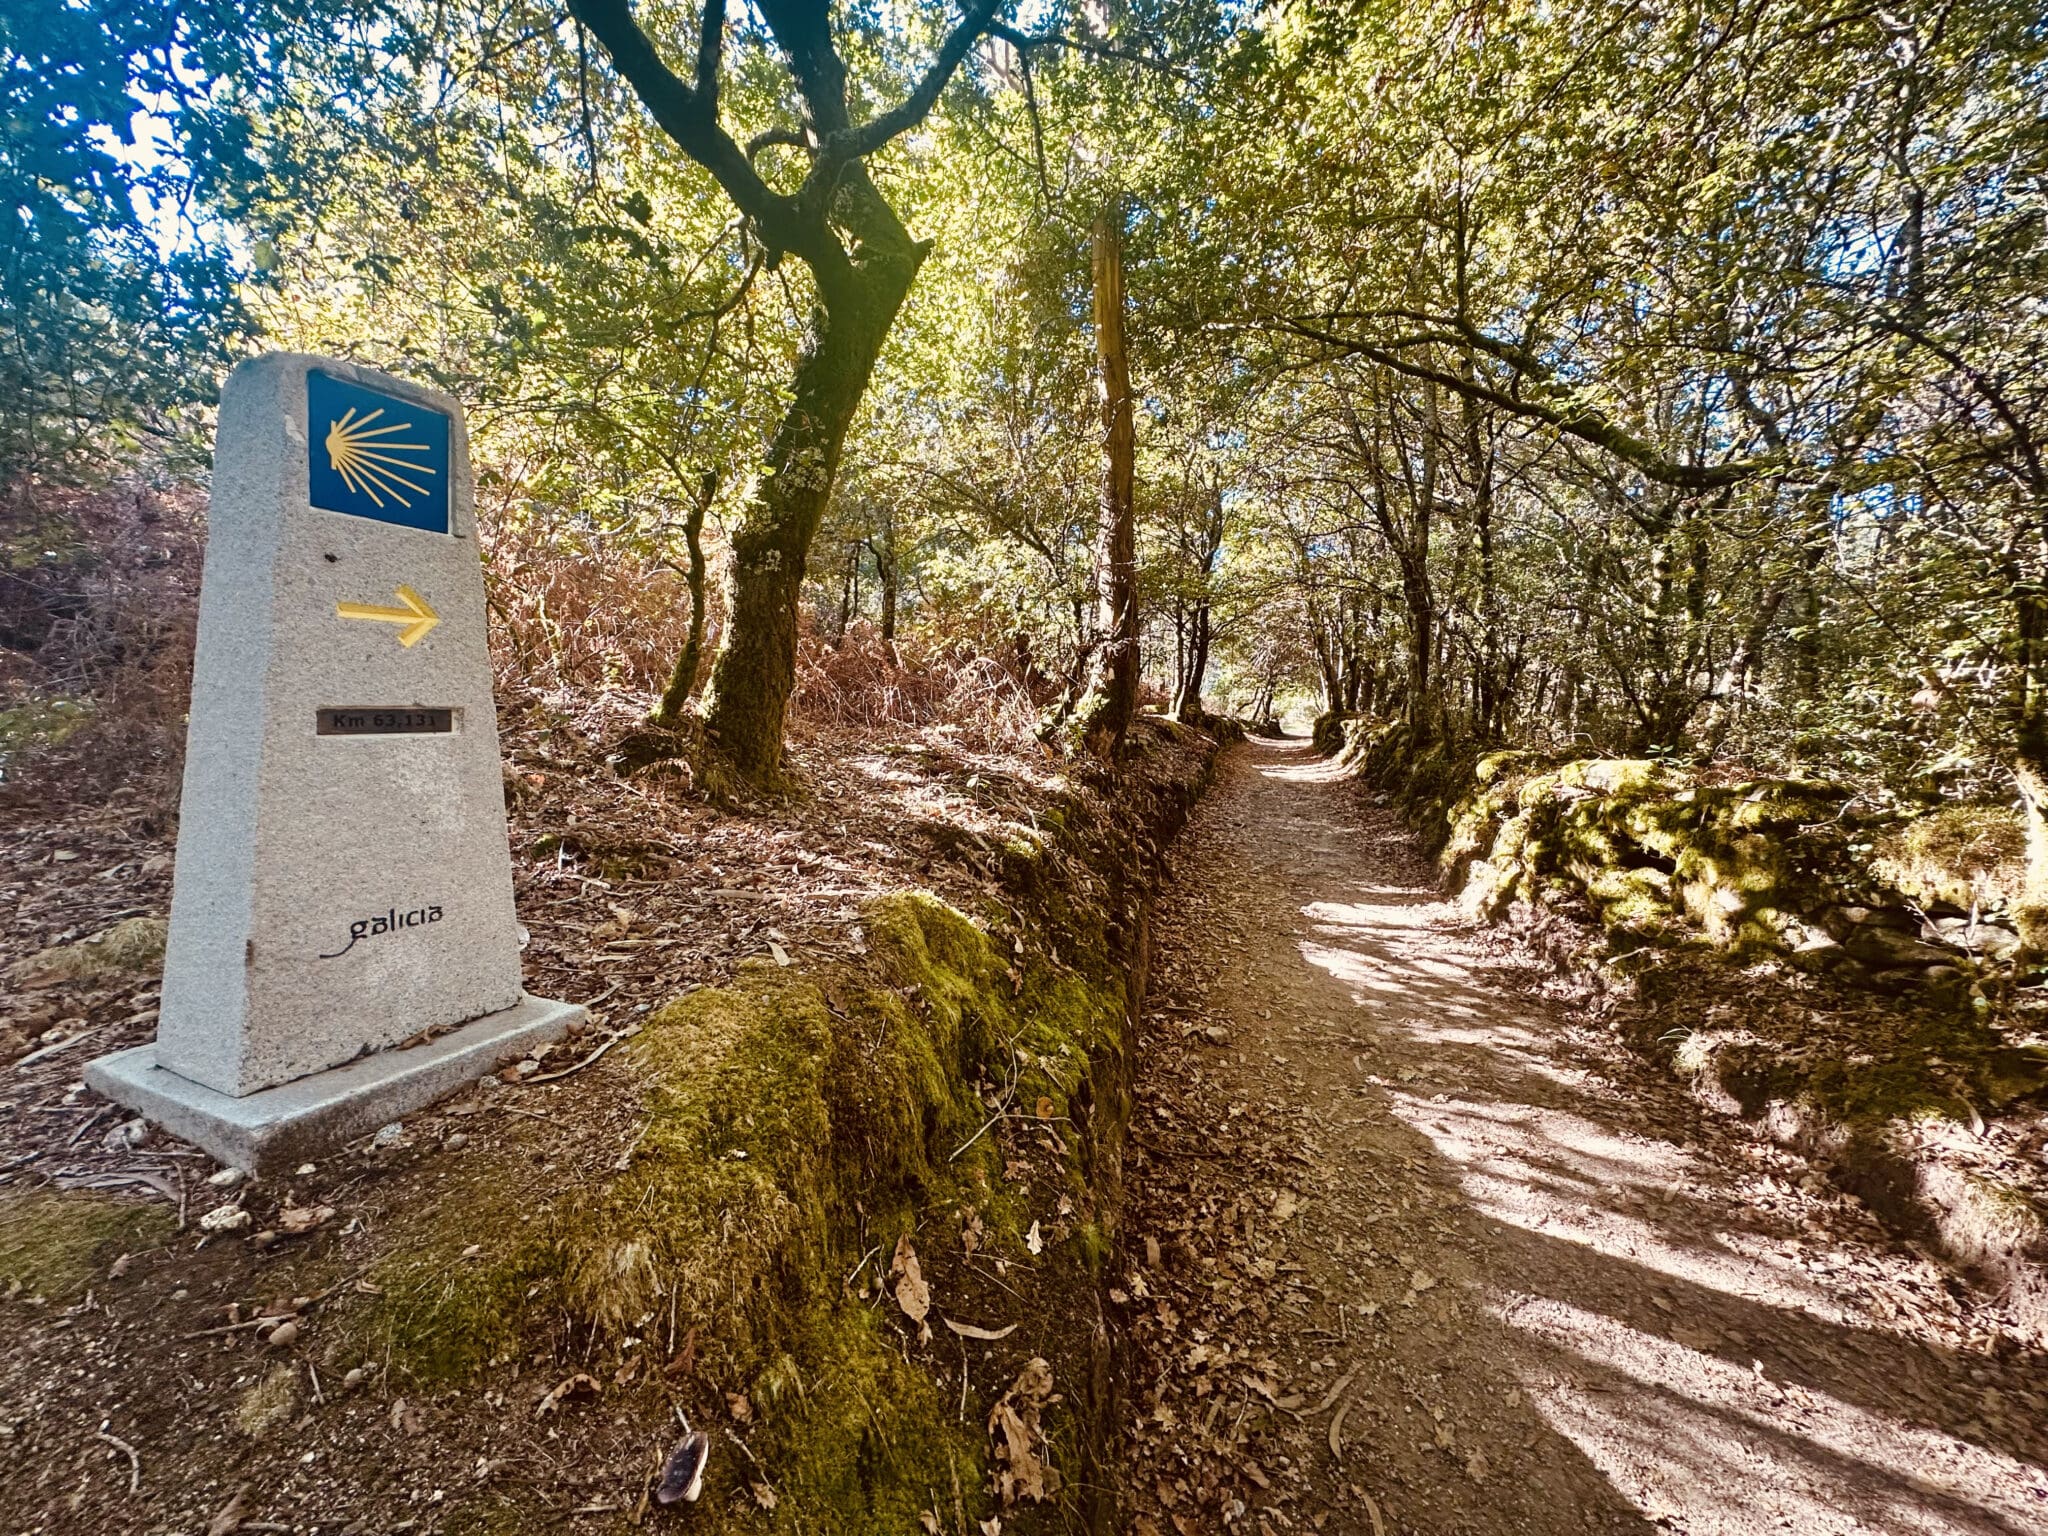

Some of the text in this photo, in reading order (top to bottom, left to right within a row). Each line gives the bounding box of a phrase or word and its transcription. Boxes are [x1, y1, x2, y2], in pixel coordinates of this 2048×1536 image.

[333, 713, 436, 728] Km 63,131
[319, 905, 443, 958] galicia
